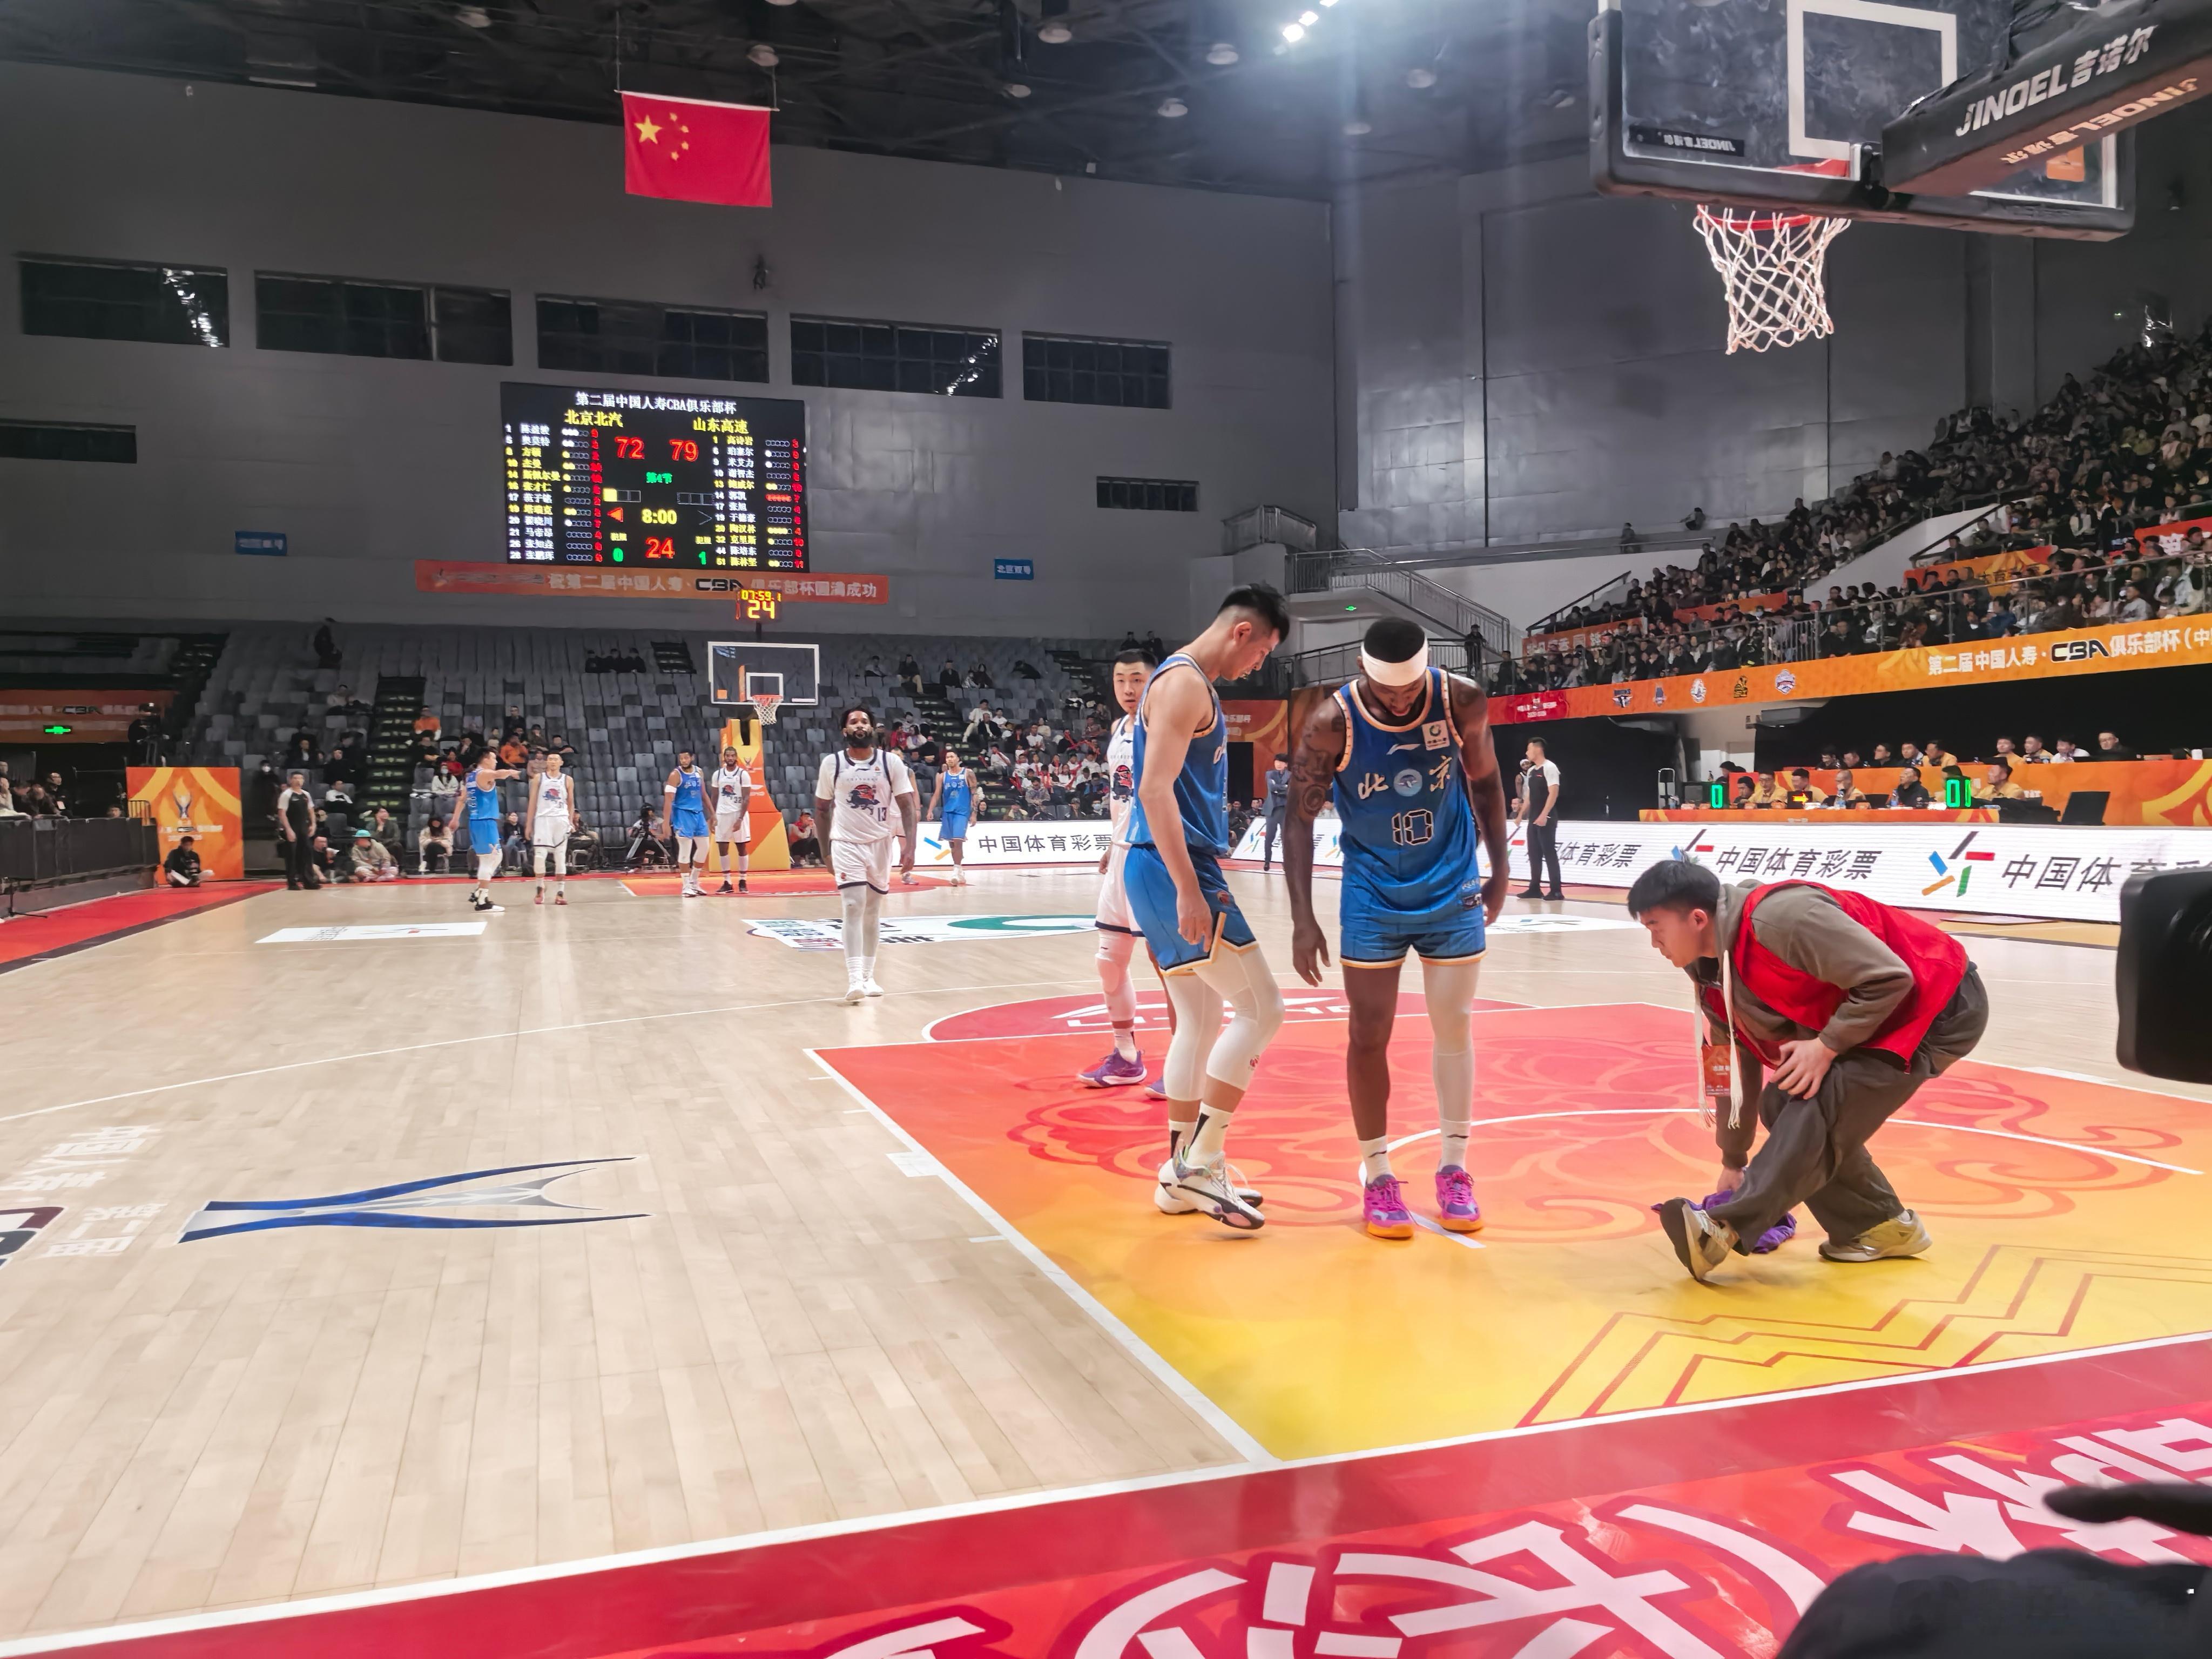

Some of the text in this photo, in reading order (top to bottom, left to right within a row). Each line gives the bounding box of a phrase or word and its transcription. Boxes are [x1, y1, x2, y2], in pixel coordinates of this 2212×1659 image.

[1955, 64, 2067, 137] JINOEL
[575, 392, 737, 415] 第二届中国人寿CBA俱乐部杯
[565, 409, 623, 427] 北京北汽
[693, 417, 748, 434] 山东高速
[615, 437, 644, 458] 72
[712, 435, 718, 443] 1
[670, 439, 698, 461] 79
[642, 509, 677, 524] 8:00
[613, 548, 623, 562] 0
[646, 537, 675, 558] 24
[699, 552, 706, 564] 1
[748, 599, 774, 619] 24
[1429, 755, 1452, 792] 京
[1711, 785, 1723, 808] 0
[878, 807, 887, 821] 13
[1392, 809, 1434, 846] 10
[979, 834, 1112, 853] 中国体育彩票
[1526, 841, 1642, 868] 体育彩票
[1716, 846, 1882, 880] 中国体育彩票
